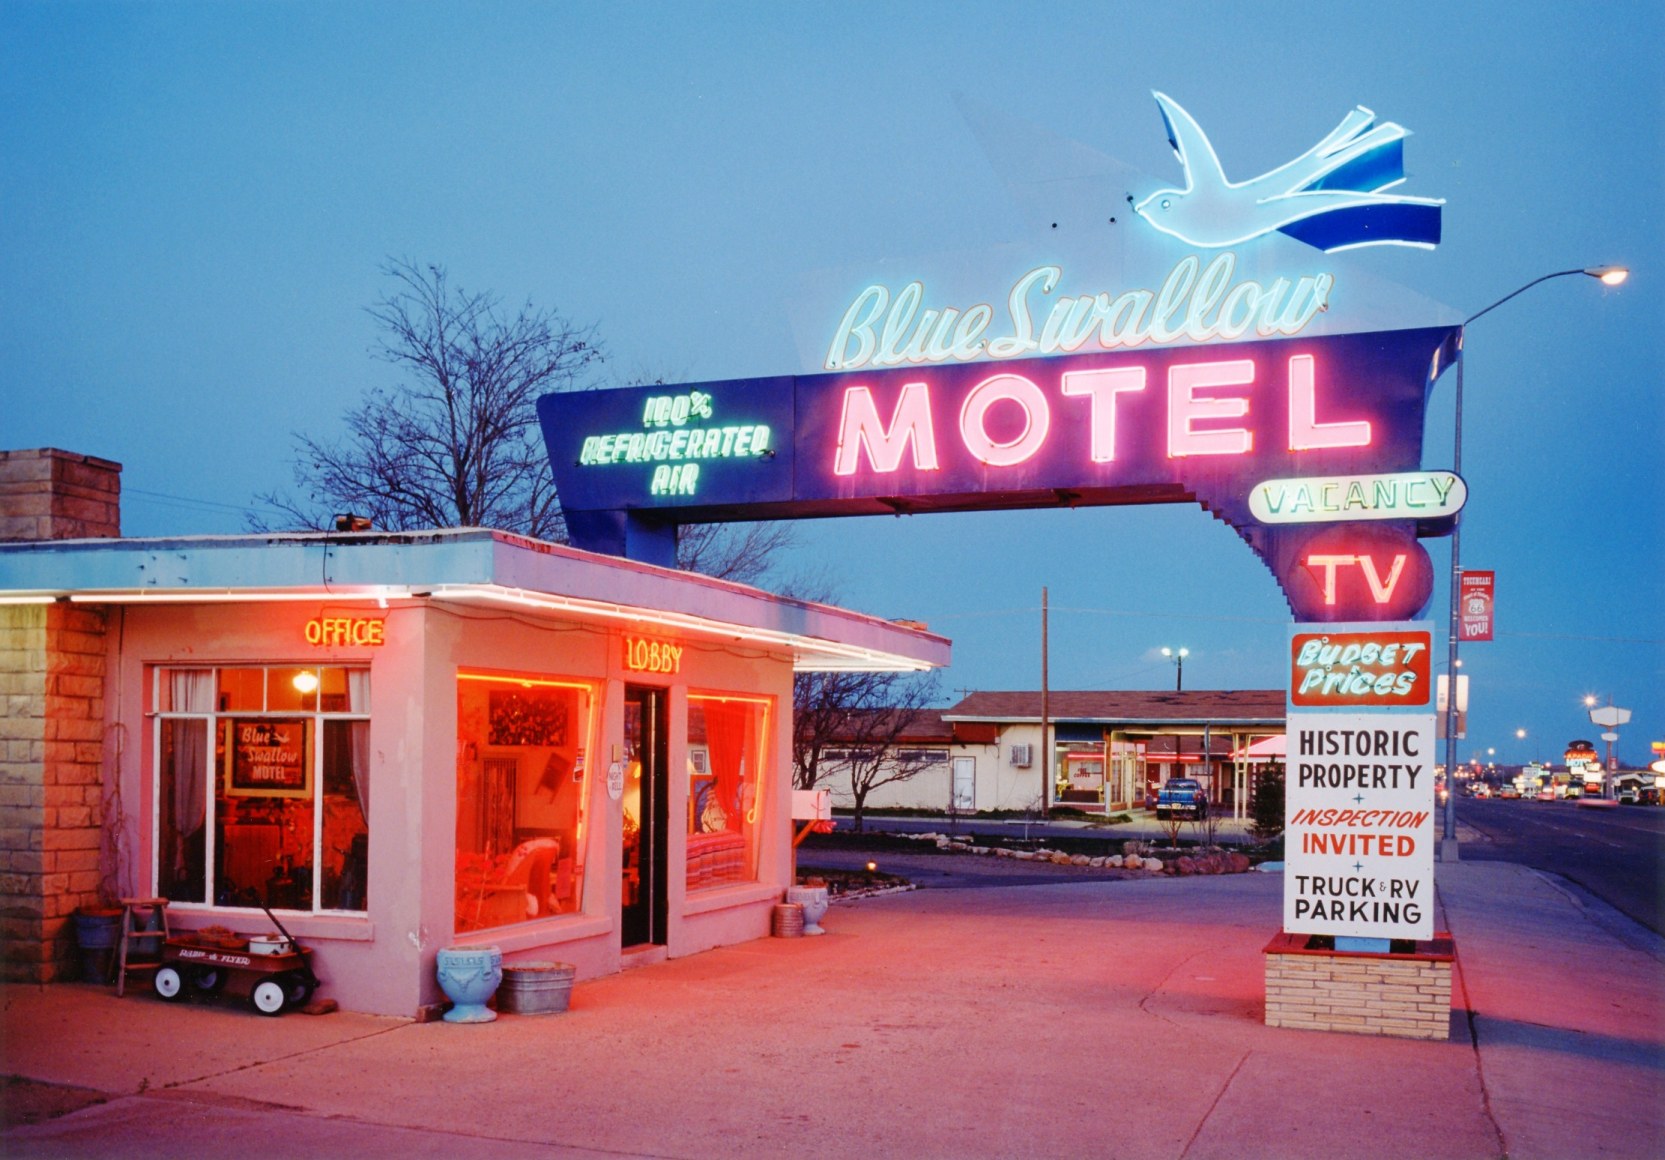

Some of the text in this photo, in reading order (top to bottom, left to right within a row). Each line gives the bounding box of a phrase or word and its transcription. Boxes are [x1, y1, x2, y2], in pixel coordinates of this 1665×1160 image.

[825, 252, 1334, 370] Blue Swallow
[643, 391, 712, 428] 100%
[834, 354, 1373, 476] MOTEL
[579, 424, 771, 465] REFRIGERATED
[650, 463, 700, 496] AIR
[1263, 476, 1456, 514] VACANCY
[1306, 554, 1407, 605] TV
[305, 619, 384, 645] OFFICE
[1465, 622, 1488, 637] YOU!
[626, 639, 683, 674] LOBBY
[241, 727, 270, 743] Blue
[1300, 730, 1419, 757] HISTORIC
[247, 747, 298, 762] Swallow
[252, 765, 286, 780] MOTEL
[1299, 763, 1423, 789] PROPERTY
[1290, 808, 1429, 829] INSPECTION
[1303, 833, 1415, 857] INVITED
[1295, 875, 1376, 898] TRUCK
[1390, 879, 1420, 899] RV
[1295, 899, 1422, 924] PARKING
[221, 955, 250, 965] FLYER
